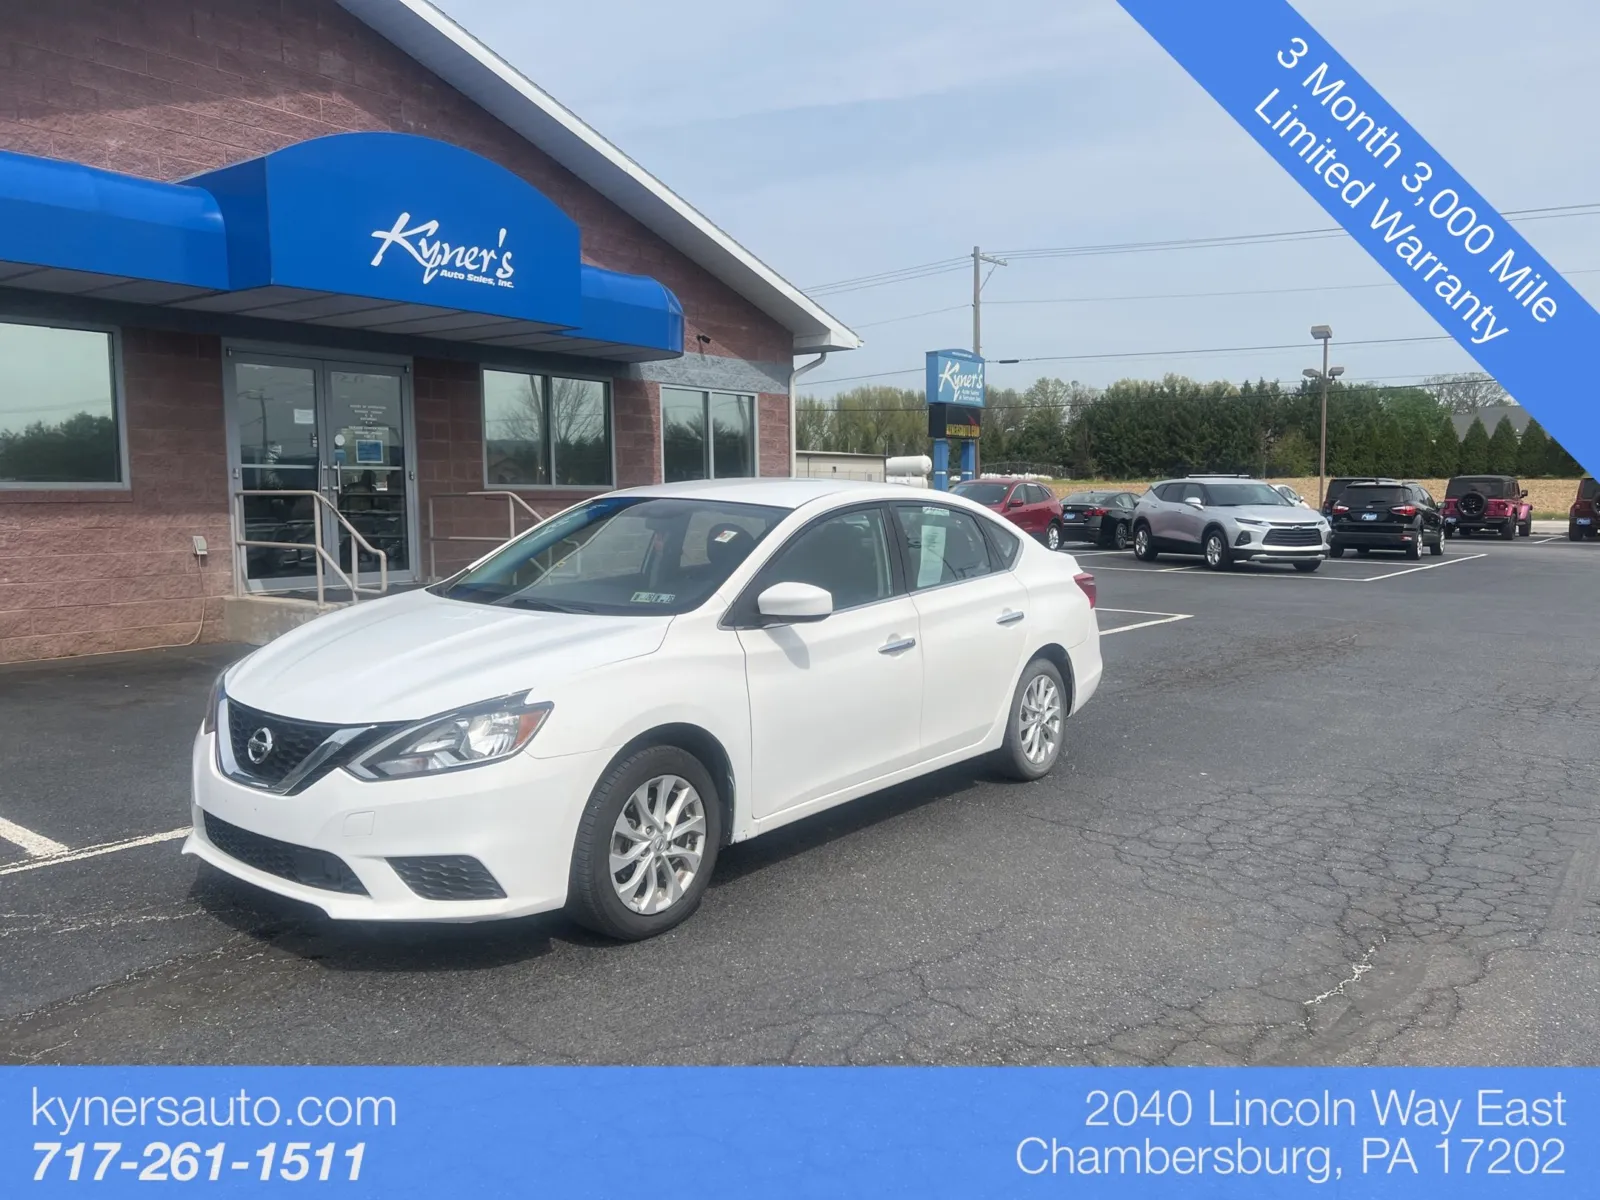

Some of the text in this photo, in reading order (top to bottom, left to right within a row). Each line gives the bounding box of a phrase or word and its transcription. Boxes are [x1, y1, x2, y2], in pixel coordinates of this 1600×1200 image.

[370, 211, 515, 285] Kyner's
[440, 269, 515, 289] Auto Sales, Inc.
[938, 360, 983, 402] Kyner's
